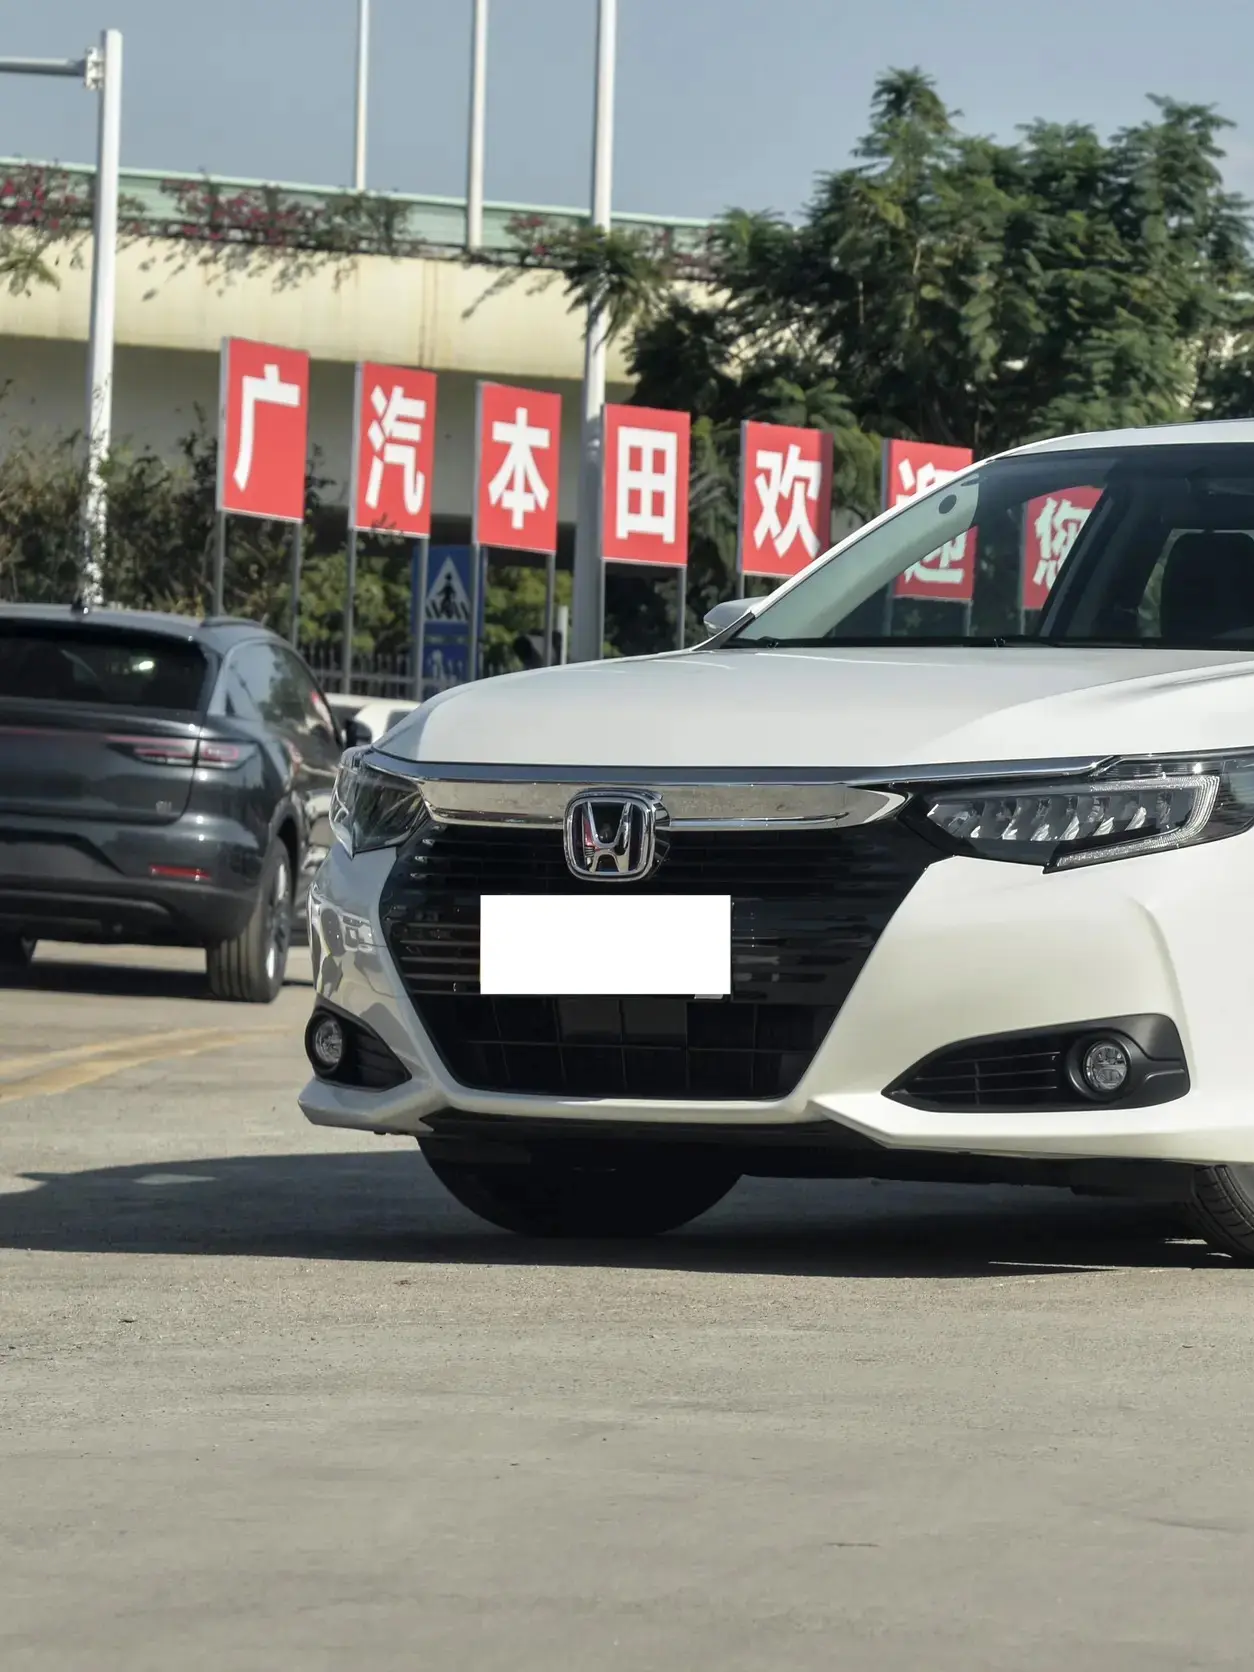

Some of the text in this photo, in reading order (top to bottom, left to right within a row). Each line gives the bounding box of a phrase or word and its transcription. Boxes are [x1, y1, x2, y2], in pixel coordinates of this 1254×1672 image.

[233, 364, 300, 491] 广
[366, 385, 426, 515] 汽
[487, 406, 551, 530] 本
[615, 425, 678, 544] 田
[753, 443, 822, 559] 欢
